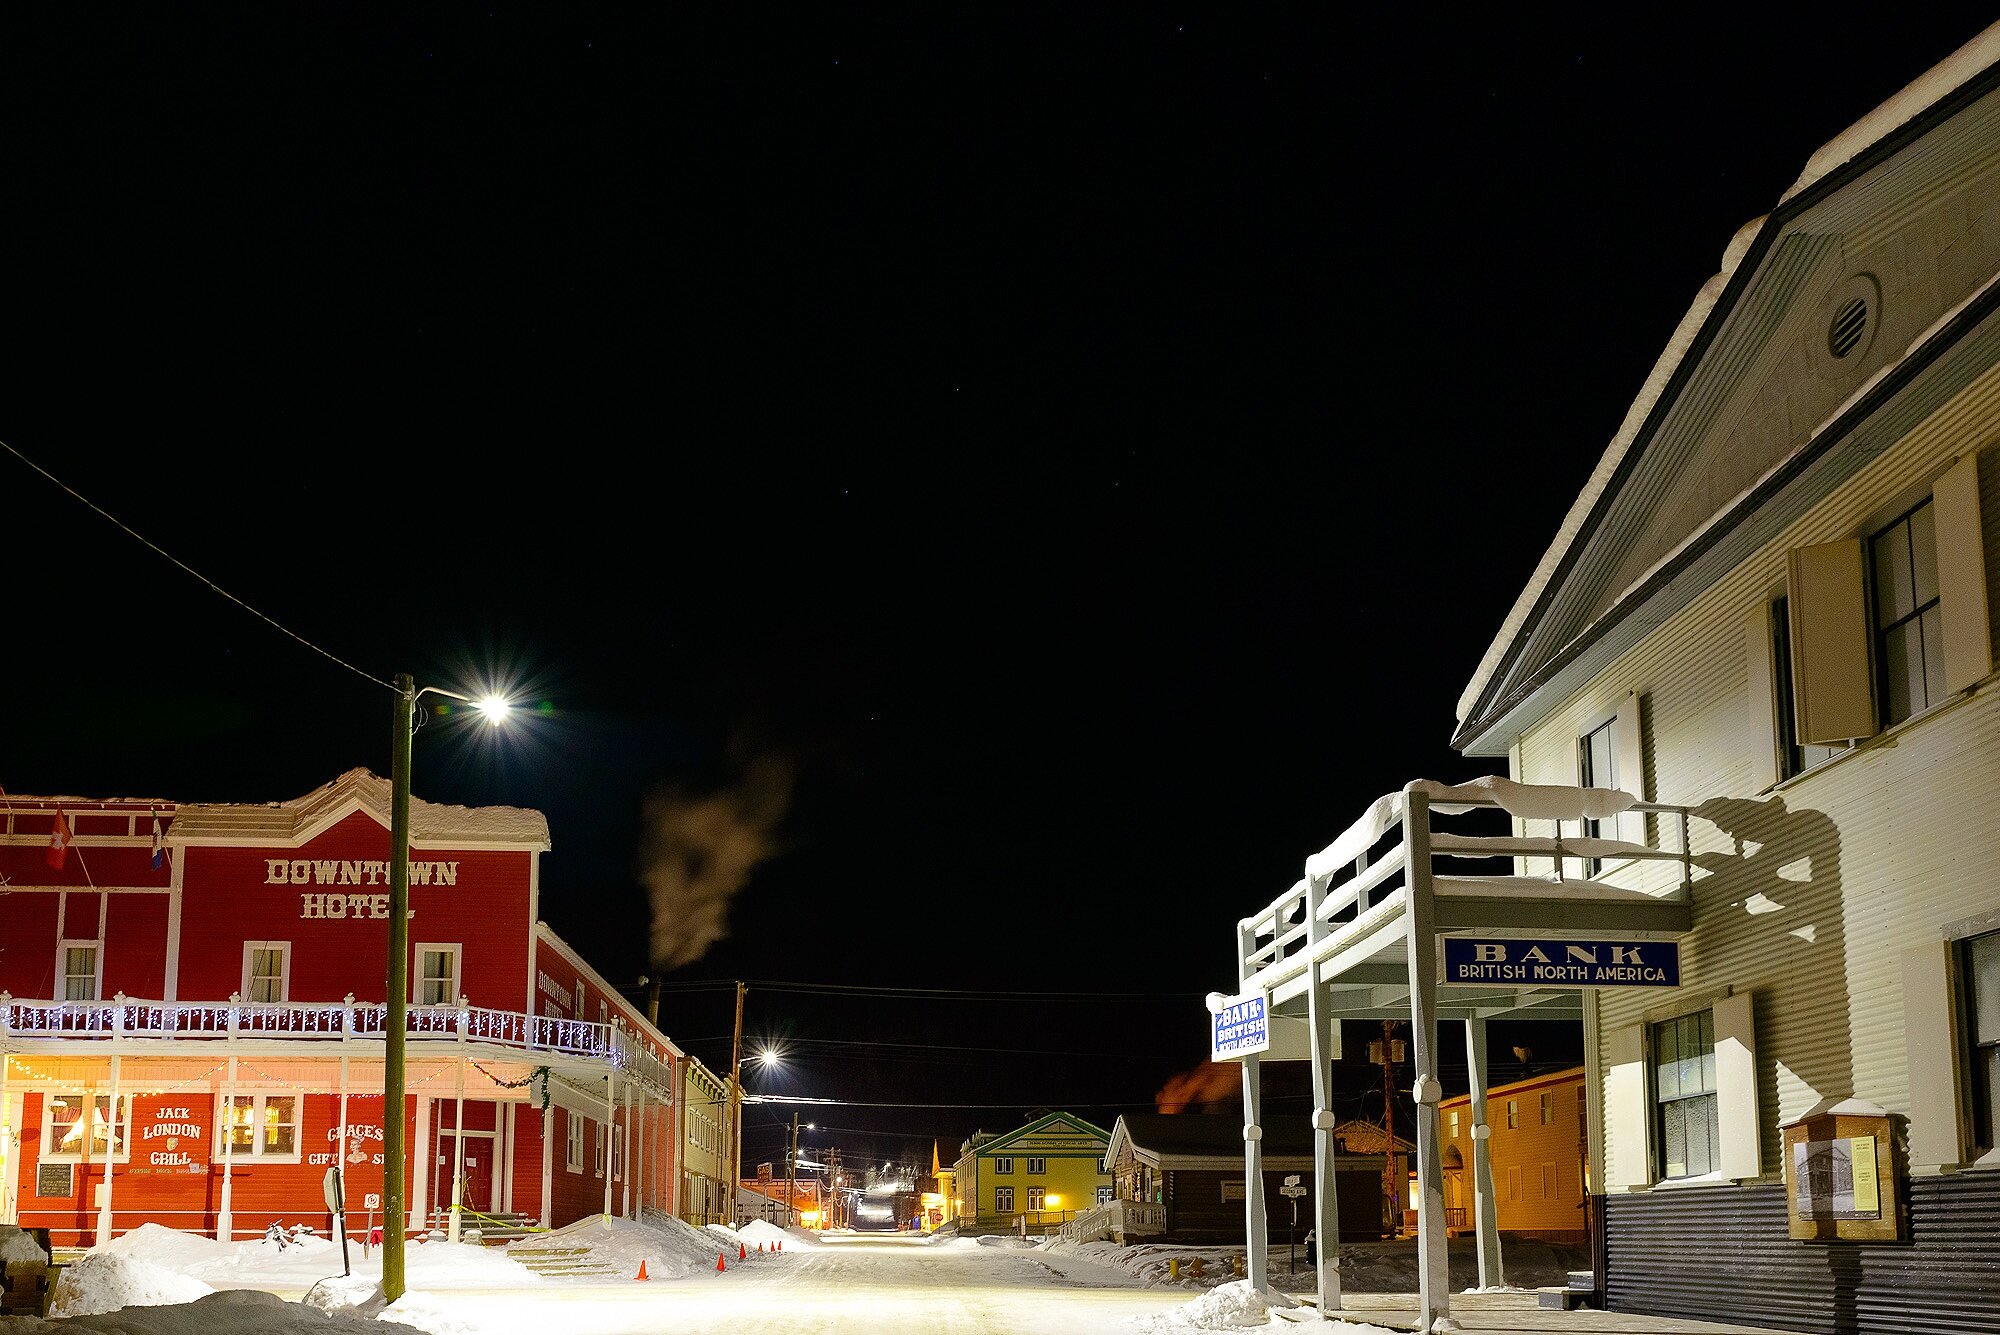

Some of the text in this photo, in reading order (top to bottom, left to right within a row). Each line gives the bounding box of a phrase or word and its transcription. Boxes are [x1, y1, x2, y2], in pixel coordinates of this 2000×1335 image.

[264, 859, 460, 886] DOWNTWN
[300, 893, 416, 919] HOTE
[1474, 944, 1644, 965] BANK
[1459, 964, 1666, 982] BRITISH NORTH AMERICA
[1218, 1019, 1265, 1042] BRITISH
[156, 1107, 190, 1119] JACK
[143, 1123, 202, 1140] LONDON
[150, 1152, 192, 1166] GRILL
[308, 1153, 339, 1165] GIFT
